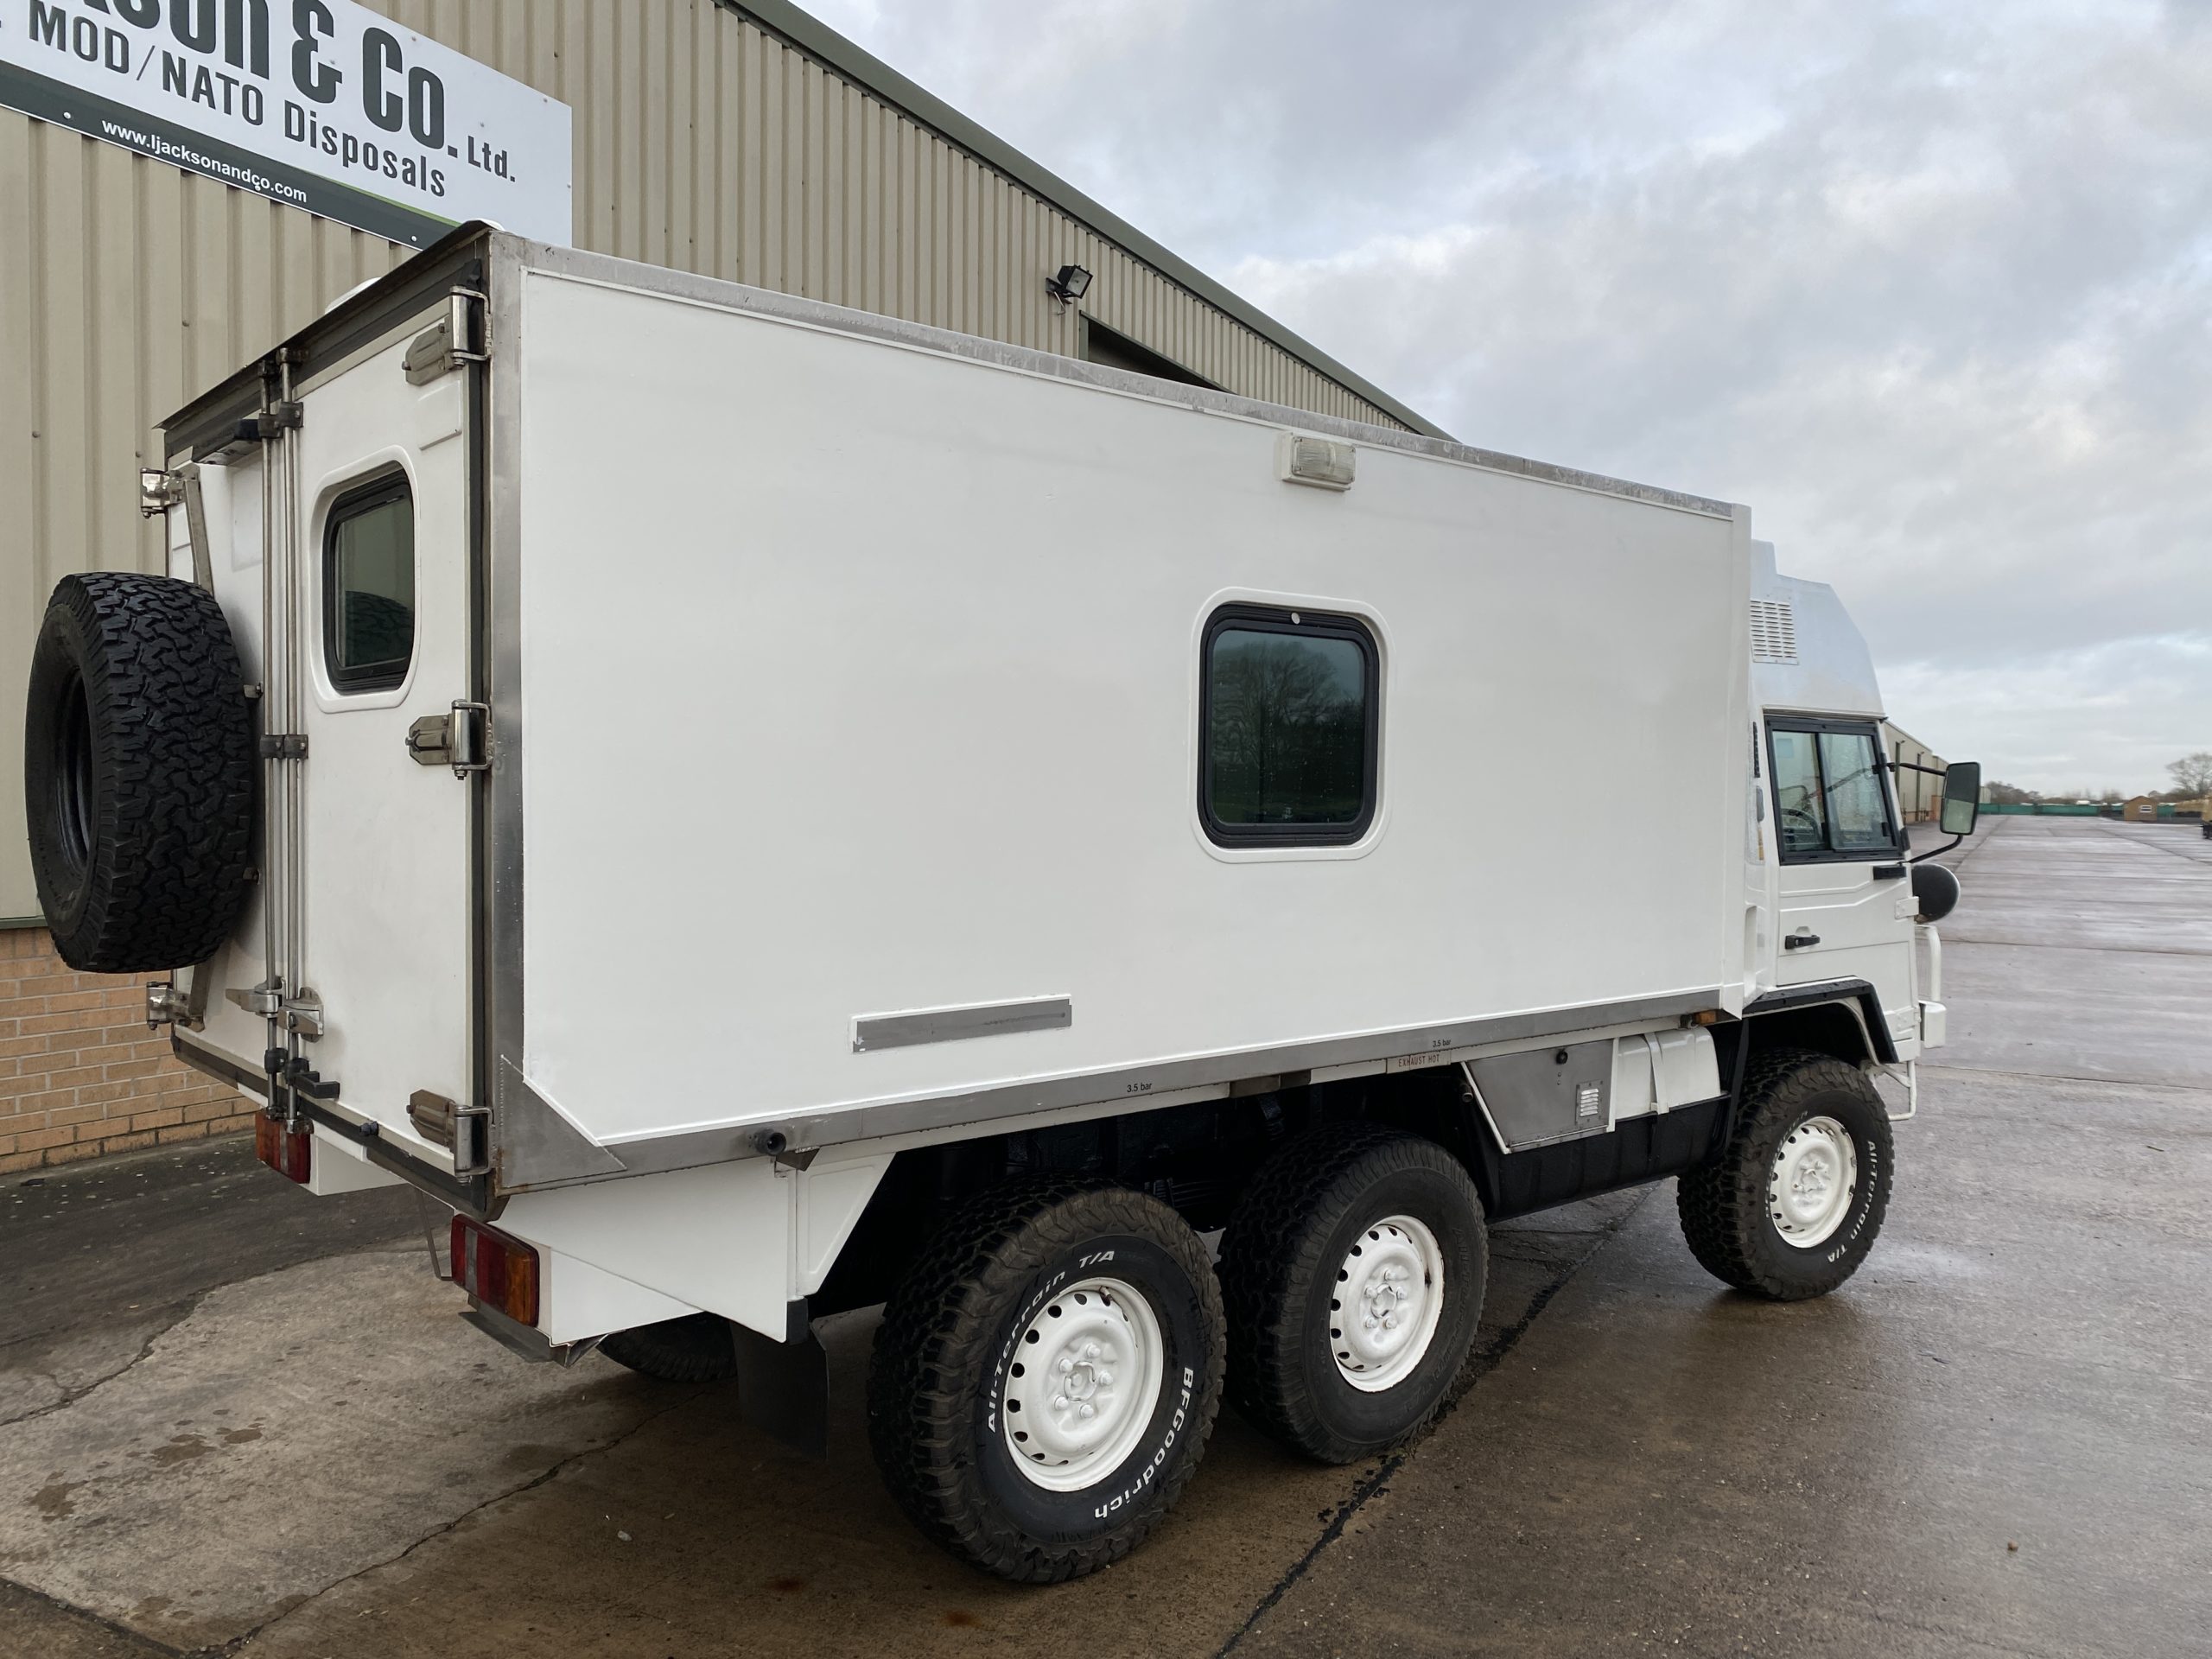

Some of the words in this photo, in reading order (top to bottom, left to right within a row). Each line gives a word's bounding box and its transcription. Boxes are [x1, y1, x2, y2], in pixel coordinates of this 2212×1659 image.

[29, 0, 264, 126] MOD/NATO
[284, 99, 445, 198] Disposals
[291, 0, 342, 104] &
[362, 27, 458, 159] Co.
[467, 135, 516, 182] Ltd.
[1127, 1084, 1139, 1093] 3.5
[1140, 1082, 1153, 1091] bar
[1398, 1055, 1426, 1067] EXHAUST
[1428, 1054, 1440, 1064] HOT
[987, 1268, 1066, 1433] All-Terrain
[1078, 1250, 1116, 1269] T/A
[1094, 1367, 1194, 1520] BFGoodrich
